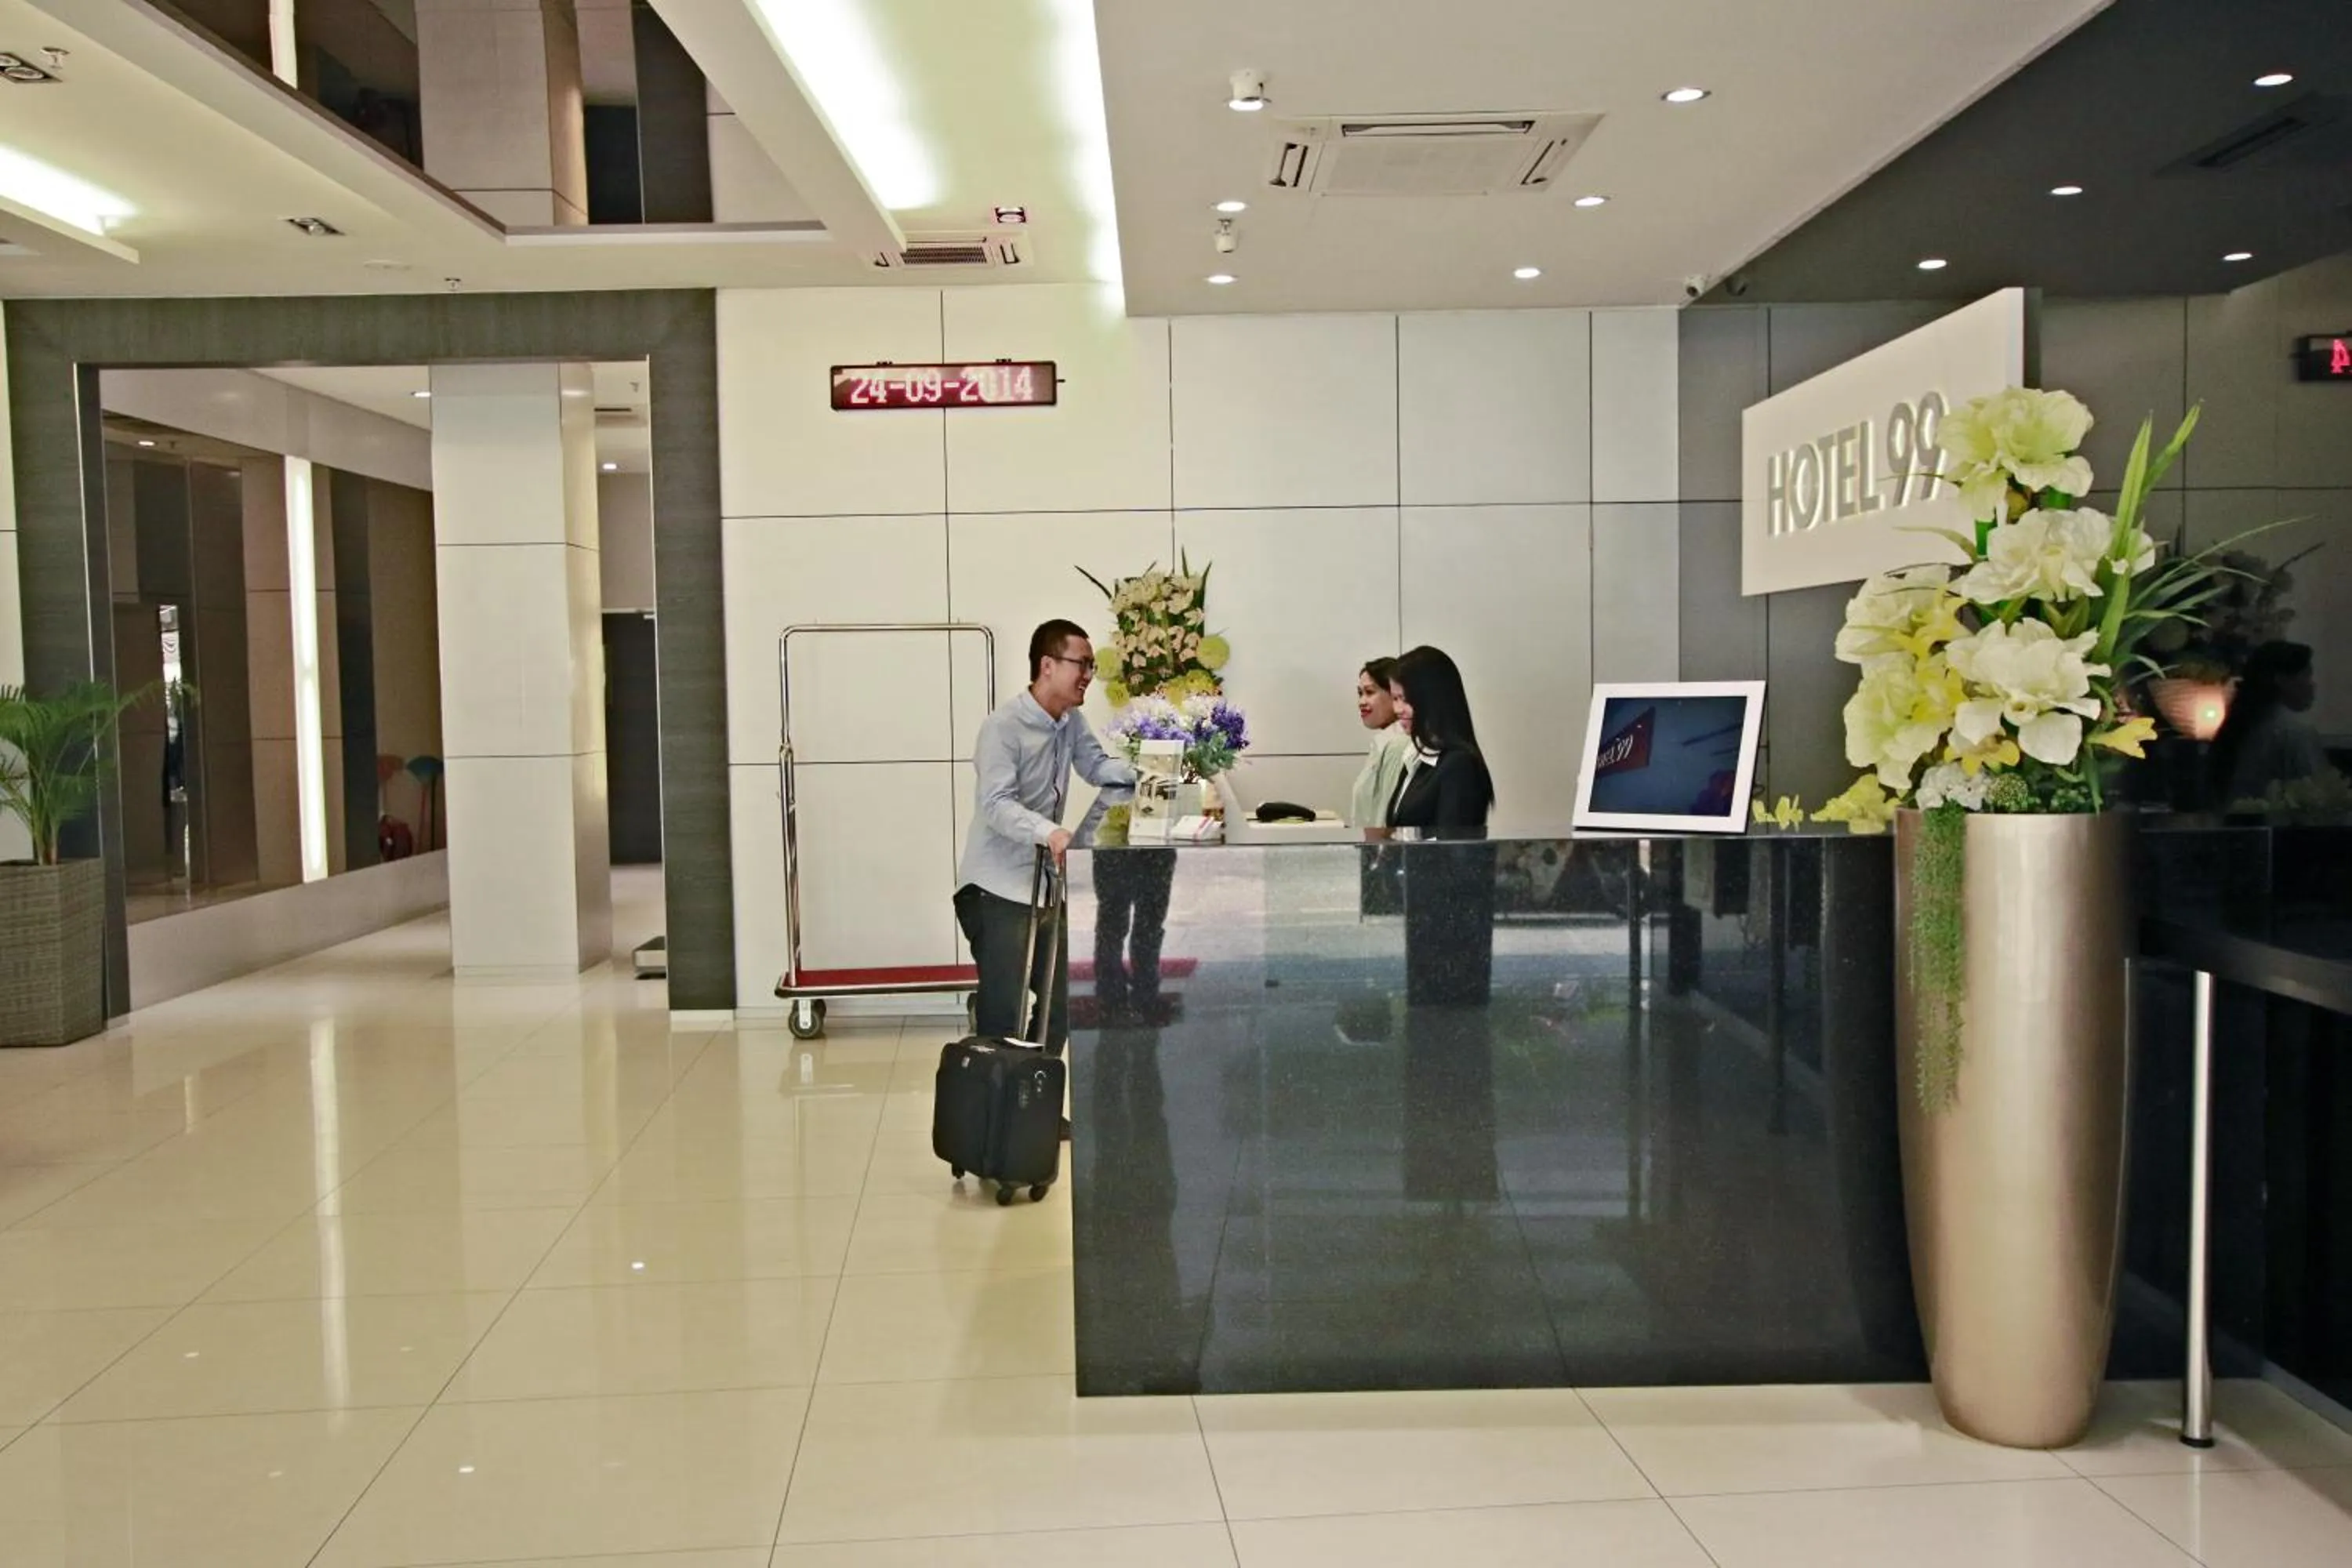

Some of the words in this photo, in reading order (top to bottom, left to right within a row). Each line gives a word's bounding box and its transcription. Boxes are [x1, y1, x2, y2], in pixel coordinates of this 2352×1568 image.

[851, 366, 1033, 403] 24-09-2014
[1767, 419, 1884, 537] HOTEL
[1886, 390, 1949, 507] 99
